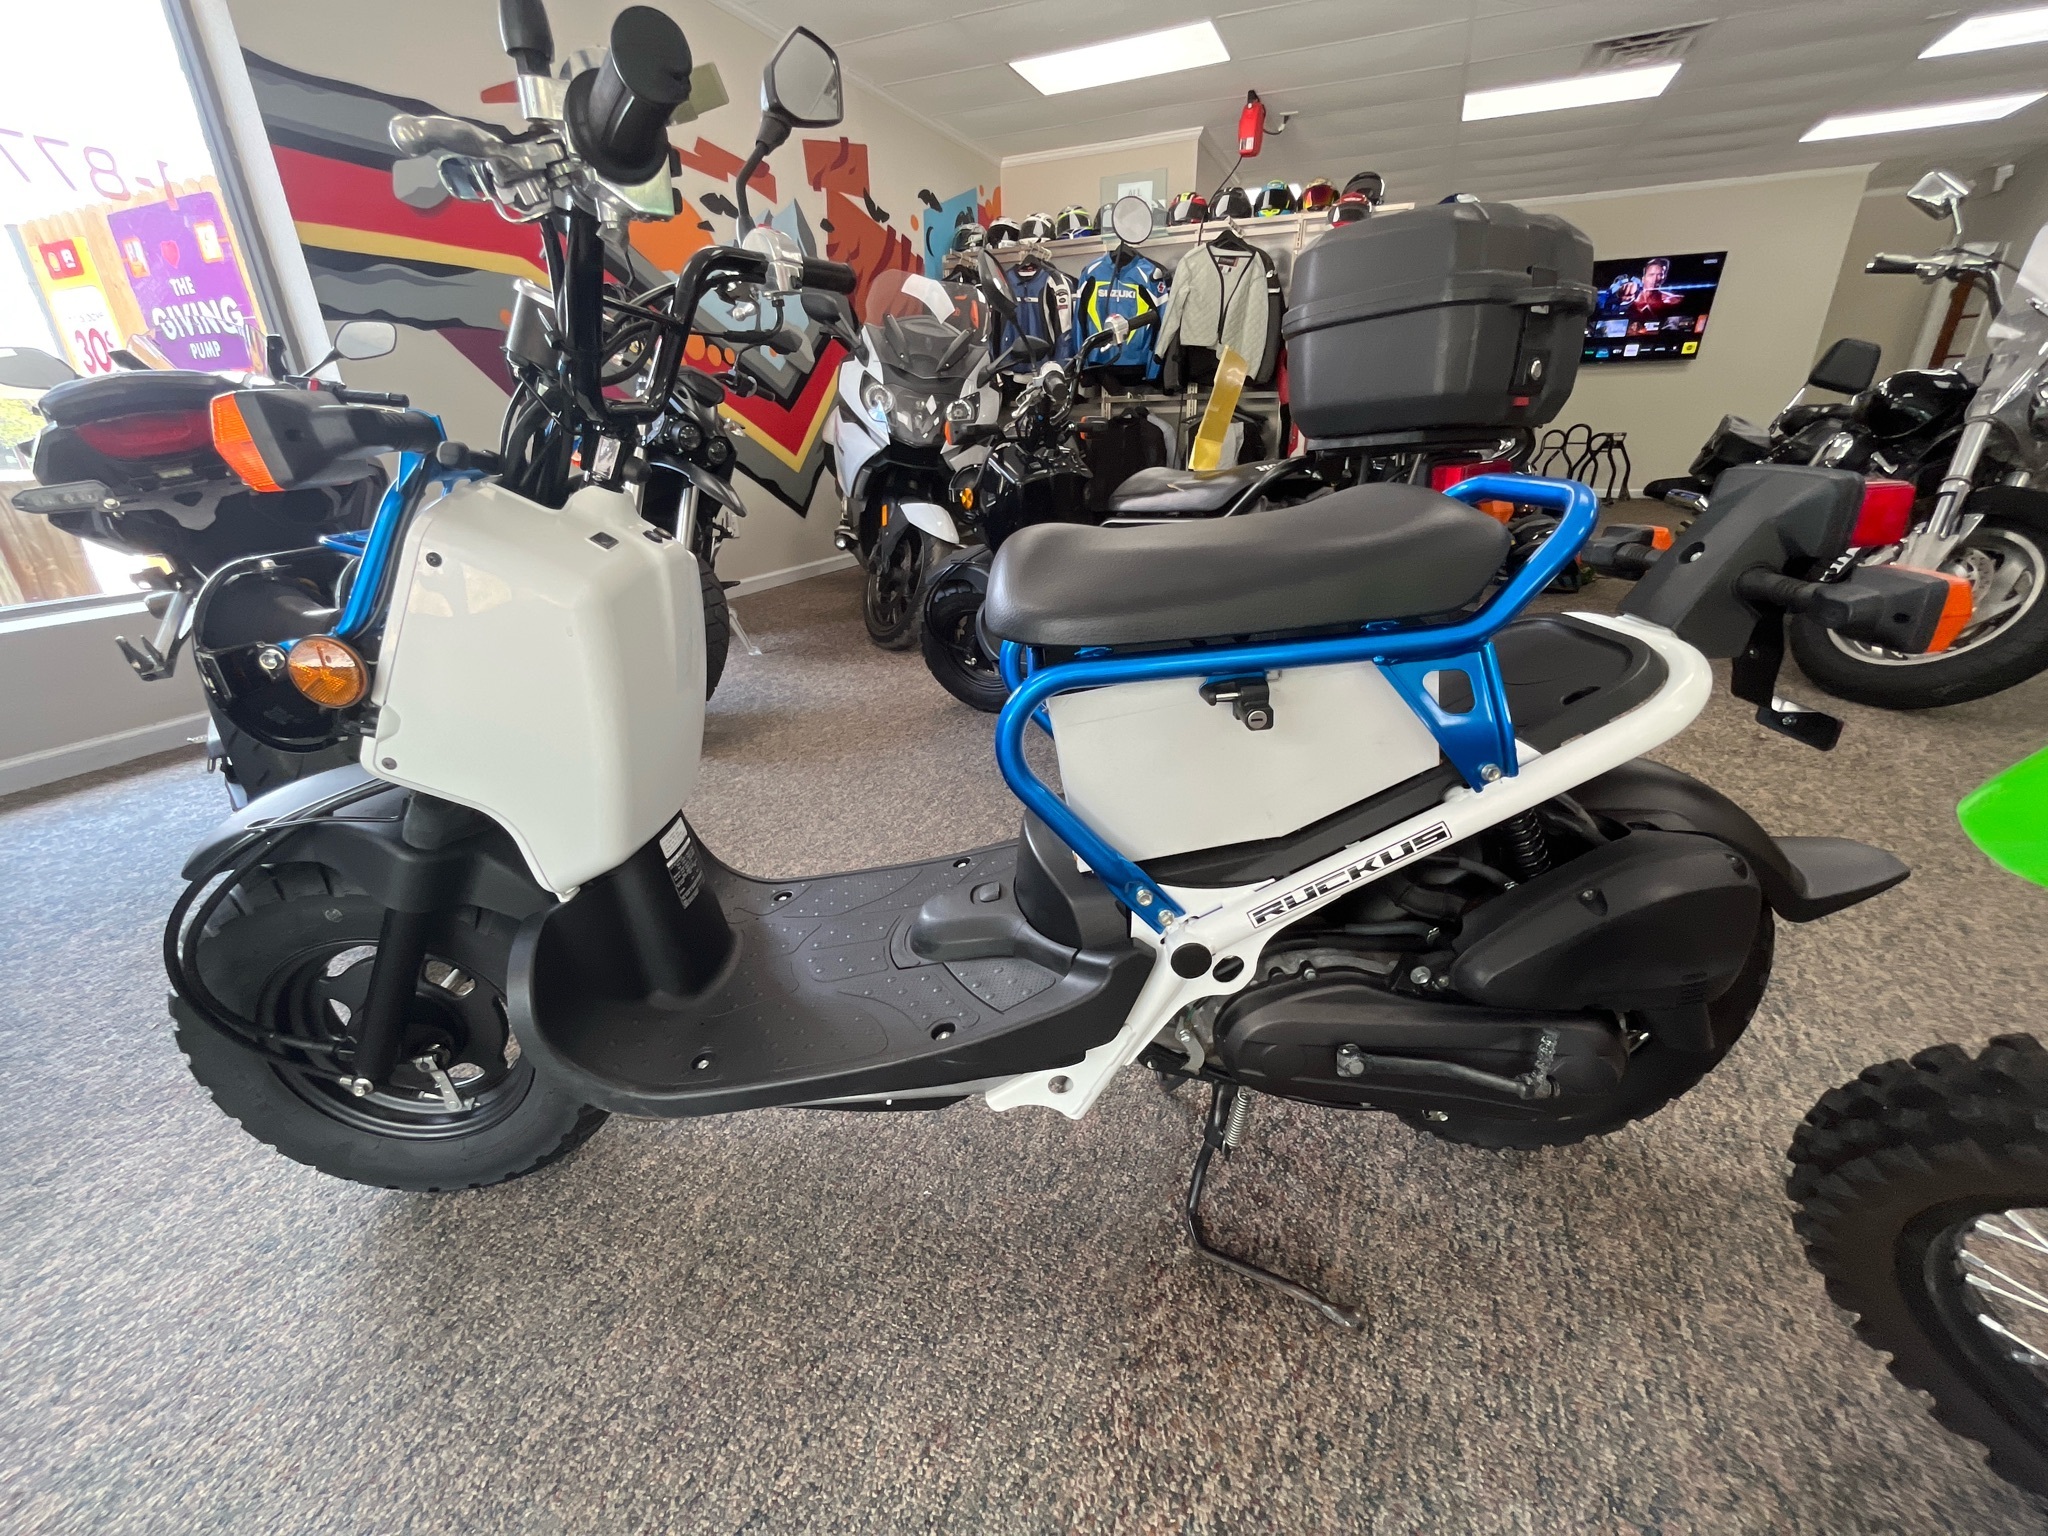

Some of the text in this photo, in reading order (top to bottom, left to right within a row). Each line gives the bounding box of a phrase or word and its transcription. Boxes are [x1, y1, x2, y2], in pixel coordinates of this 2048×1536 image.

[168, 275, 197, 297] THE
[151, 296, 245, 341] GIVING
[188, 340, 222, 360] PUMP
[1252, 825, 1448, 925] RUCKUS
